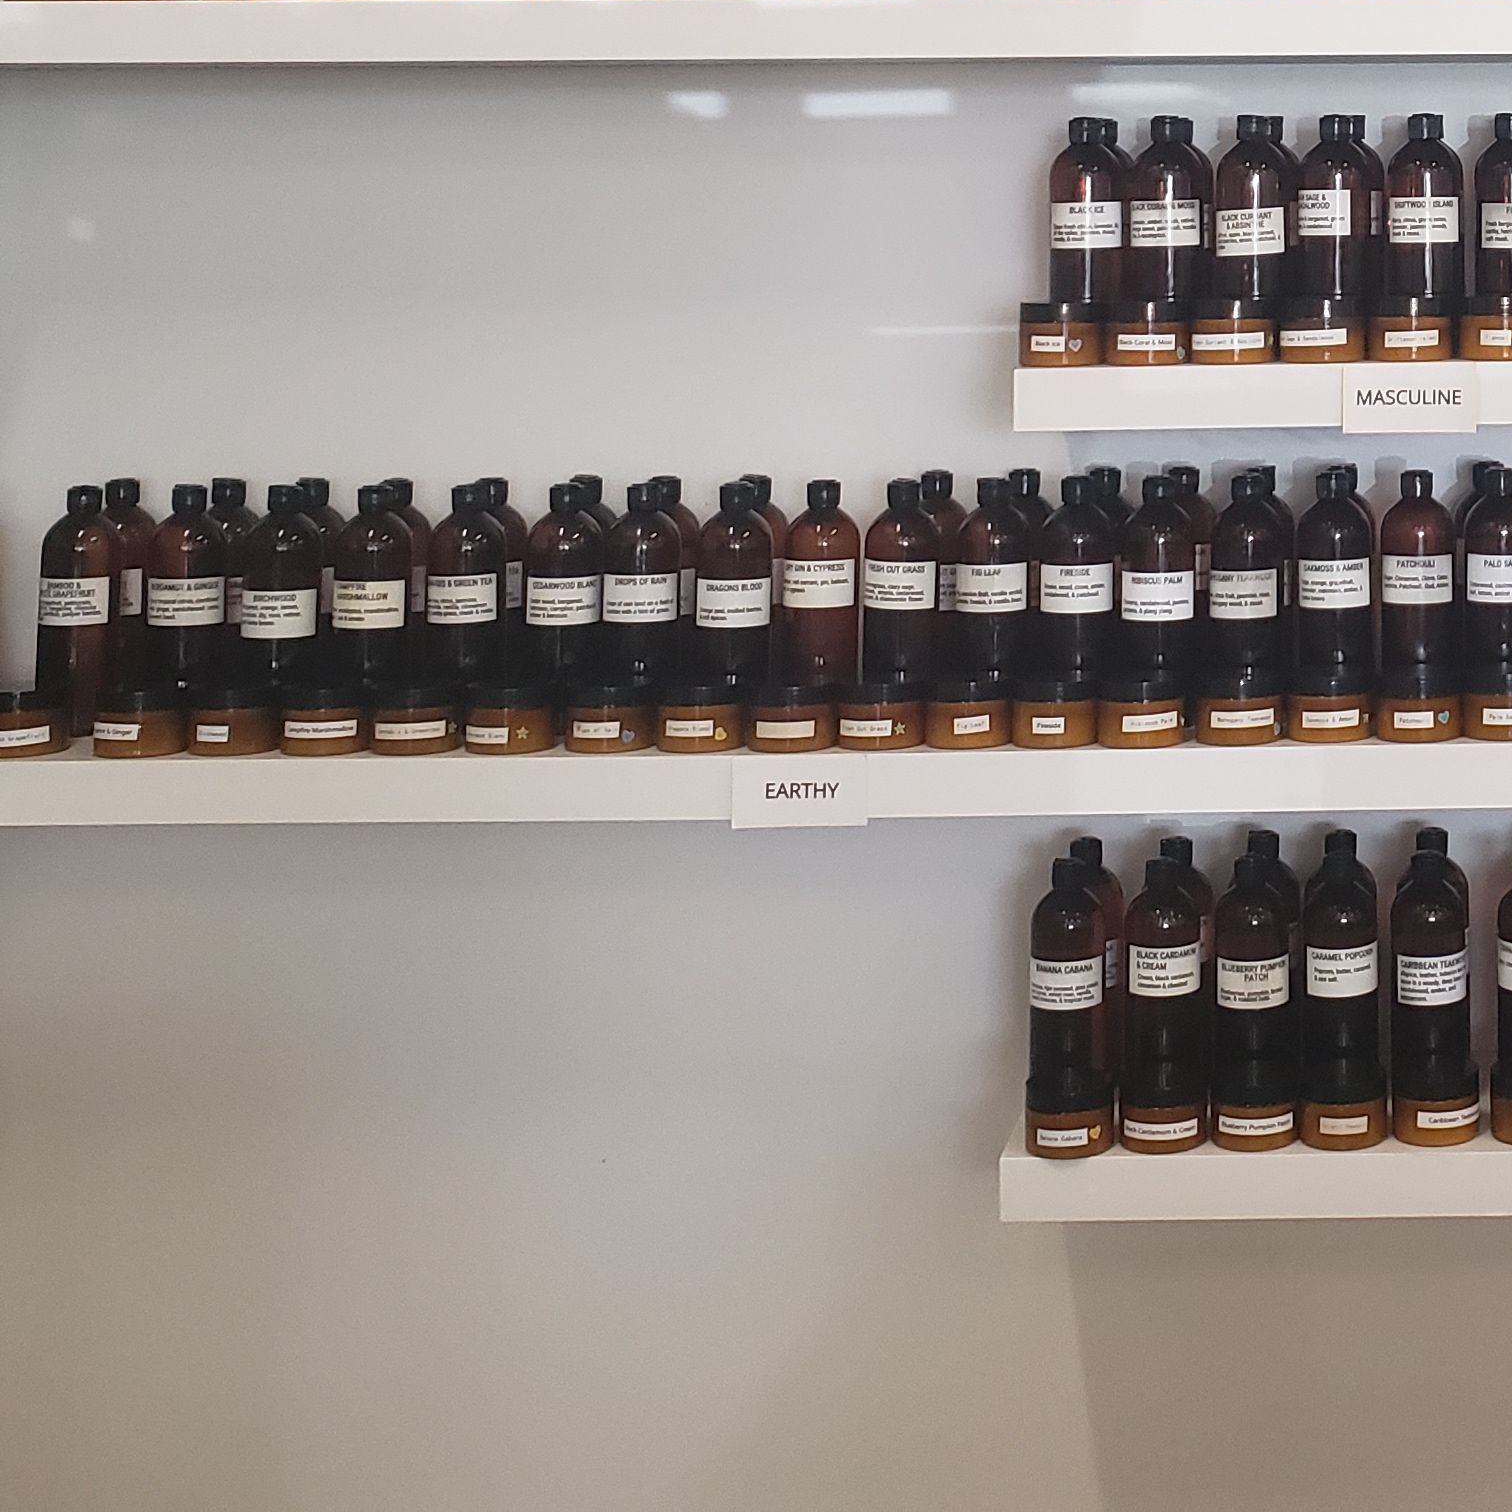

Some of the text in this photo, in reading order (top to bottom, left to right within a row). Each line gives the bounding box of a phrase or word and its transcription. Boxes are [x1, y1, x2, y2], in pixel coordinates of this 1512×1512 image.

[1240, 210, 1273, 221] CURANT
[1356, 389, 1462, 406] MASCULINE
[765, 782, 840, 799] EARTHY
[1243, 972, 1270, 984] PATCH
